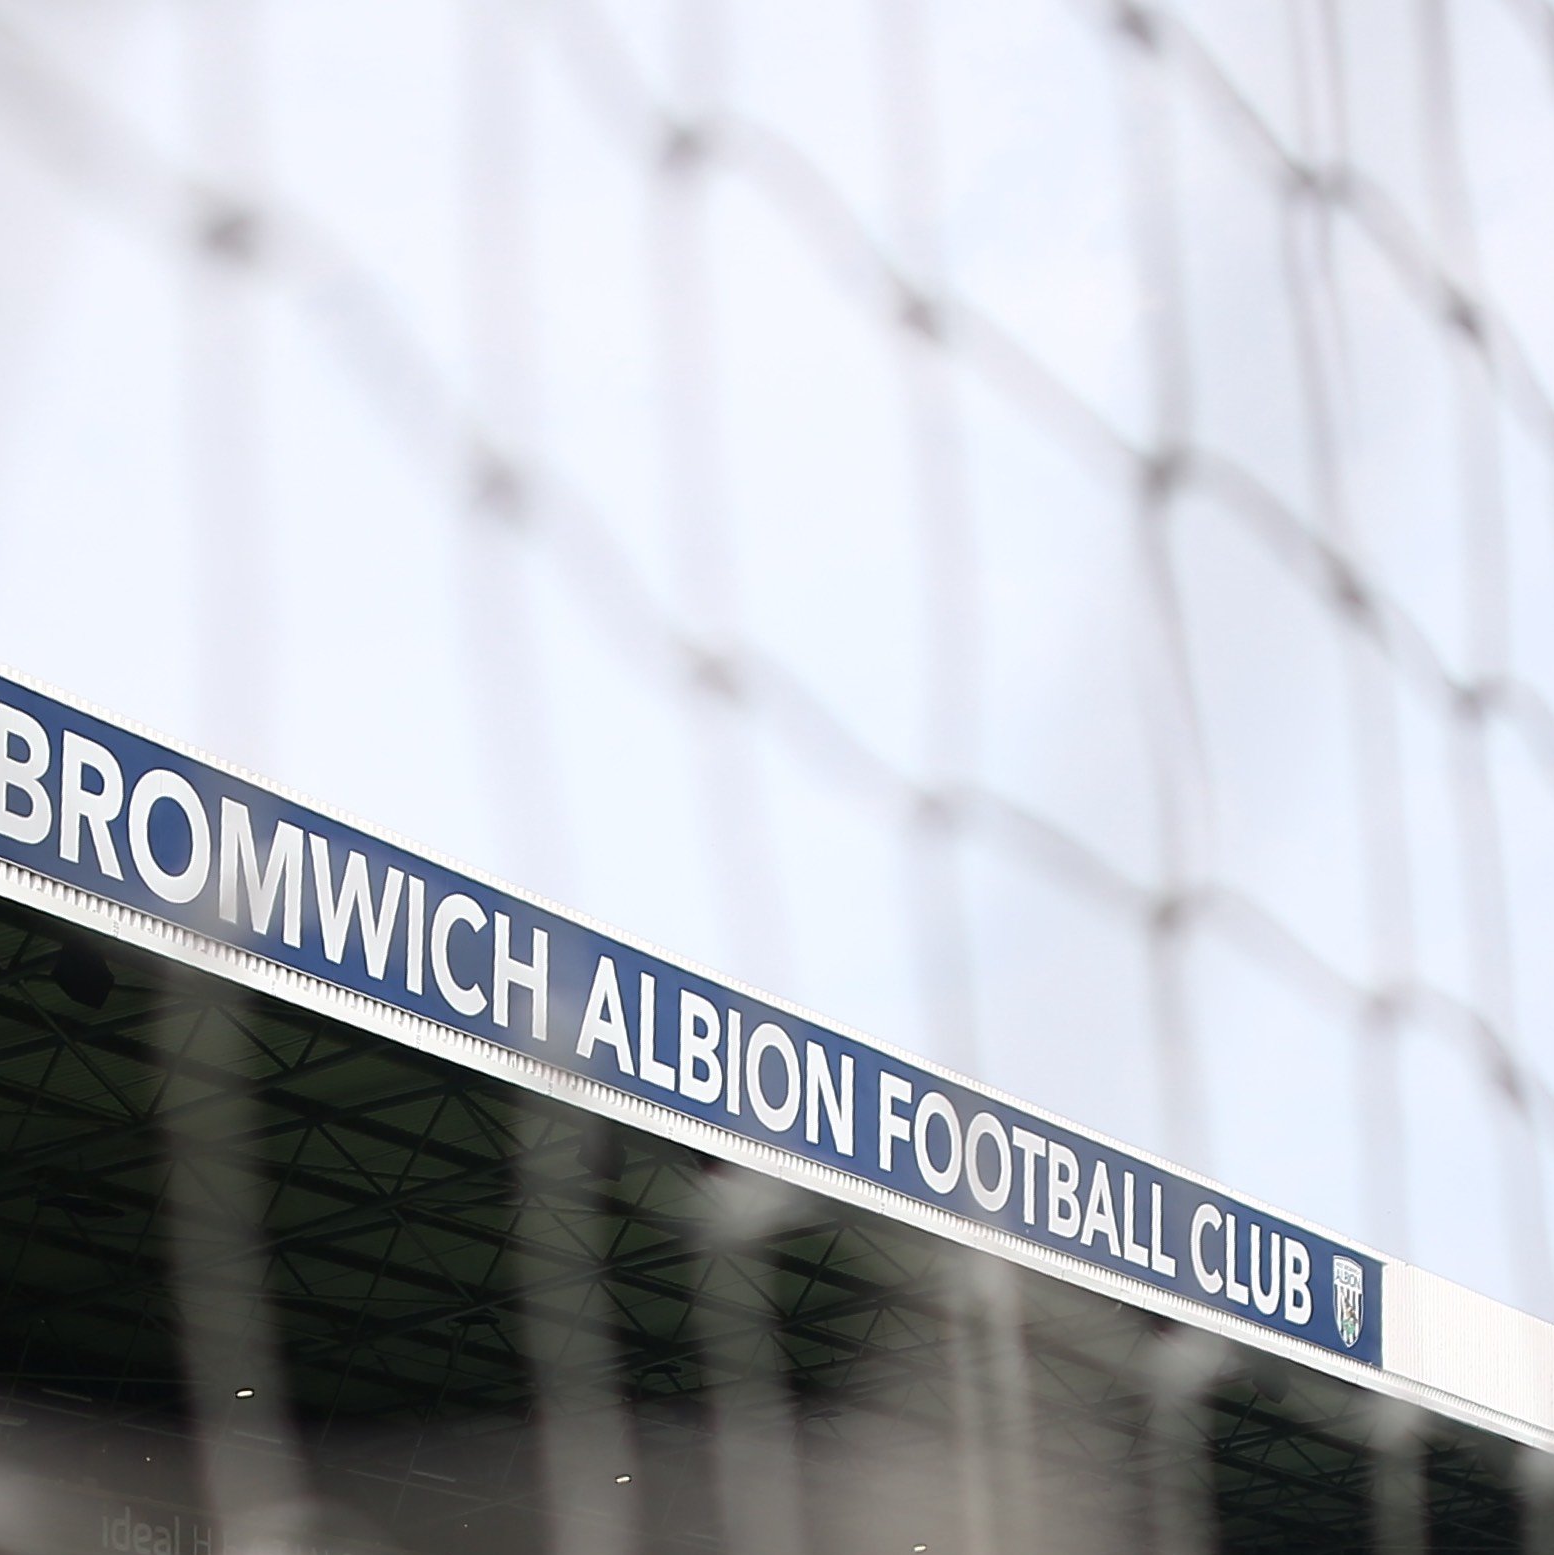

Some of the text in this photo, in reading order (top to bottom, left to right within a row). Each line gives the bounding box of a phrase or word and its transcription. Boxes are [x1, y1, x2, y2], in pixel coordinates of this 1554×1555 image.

[576, 955, 855, 1158] ALBION
[878, 1070, 1177, 1279] FOOTBALL
[1189, 1203, 1313, 1326] CLUB
